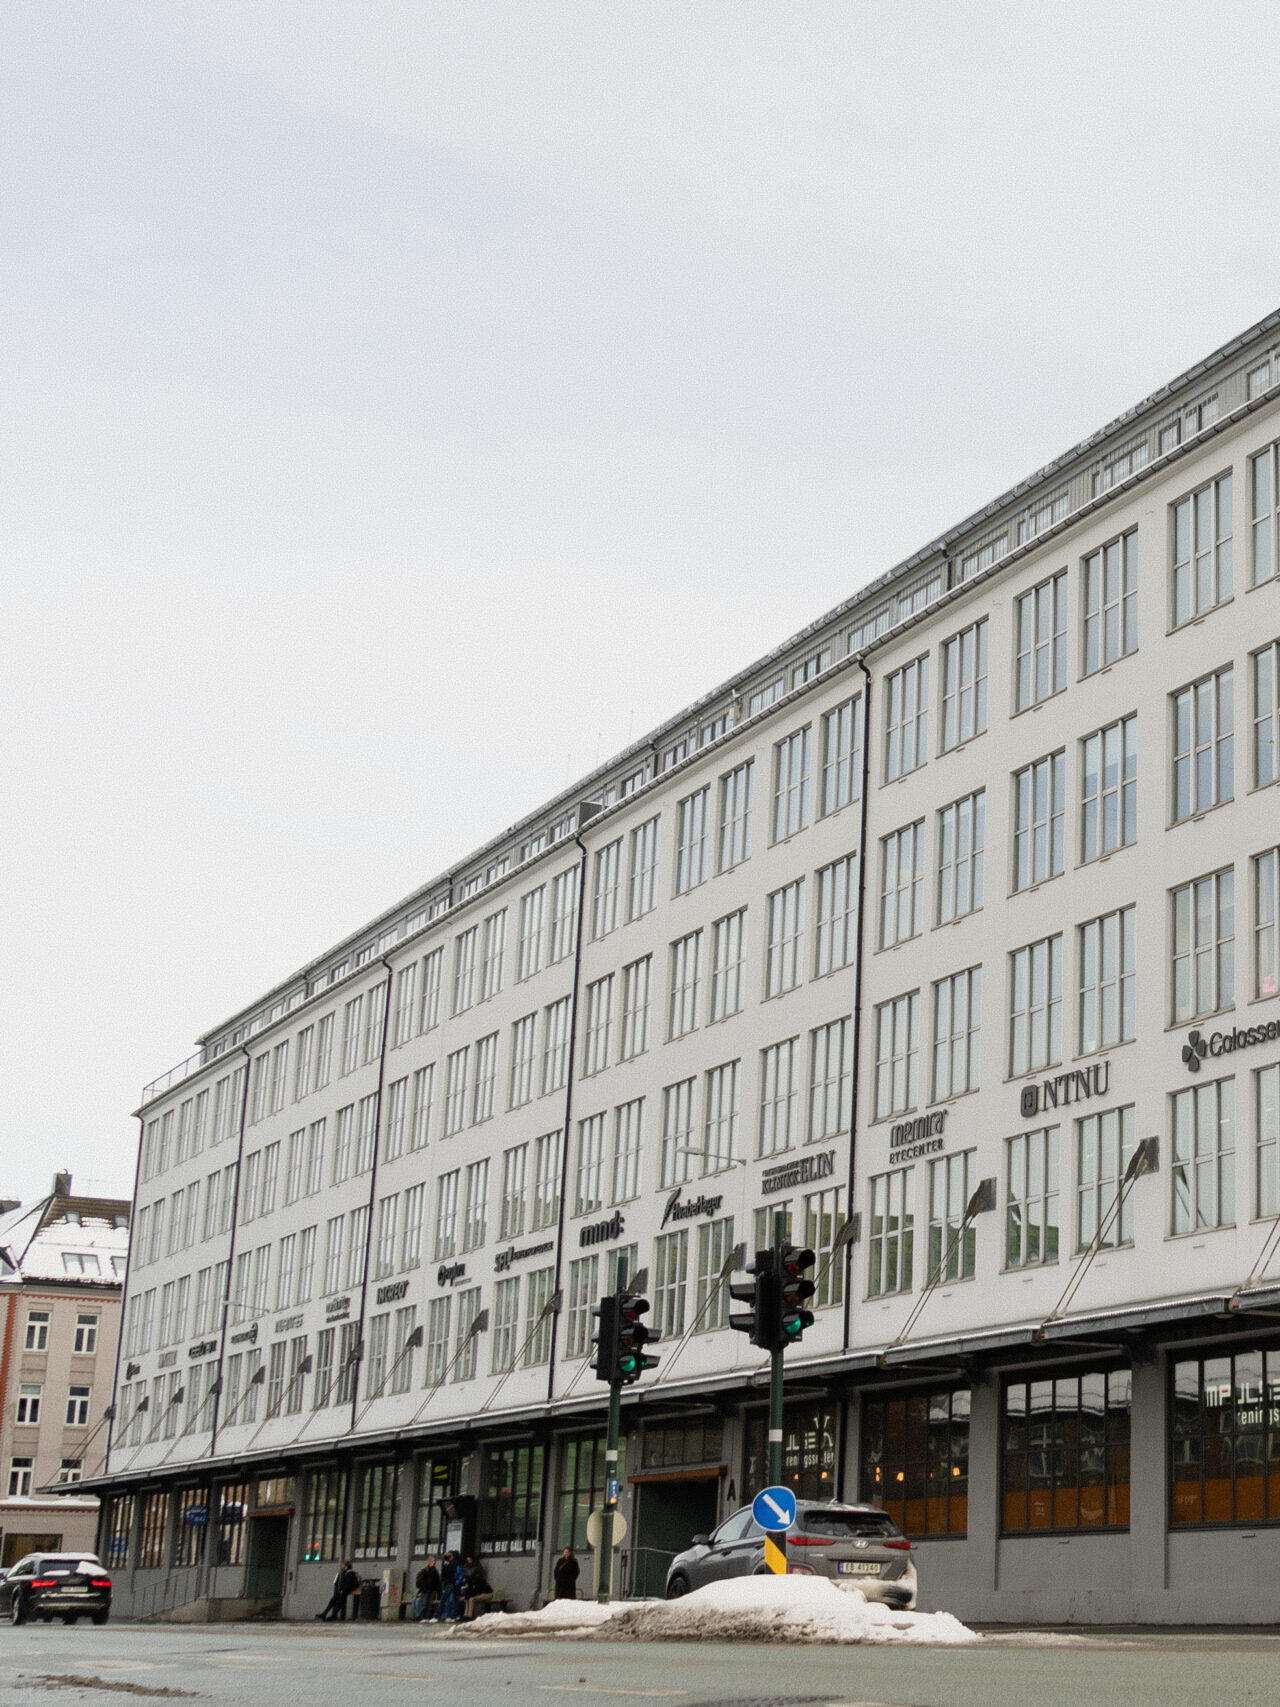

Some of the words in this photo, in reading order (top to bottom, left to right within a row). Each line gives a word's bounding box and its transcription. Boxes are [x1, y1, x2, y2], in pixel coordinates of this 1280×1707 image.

[1042, 1060, 1111, 1112] NTNU
[890, 1110, 944, 1148] memira
[800, 1149, 836, 1184] ELIN
[727, 1479, 736, 1501] A
